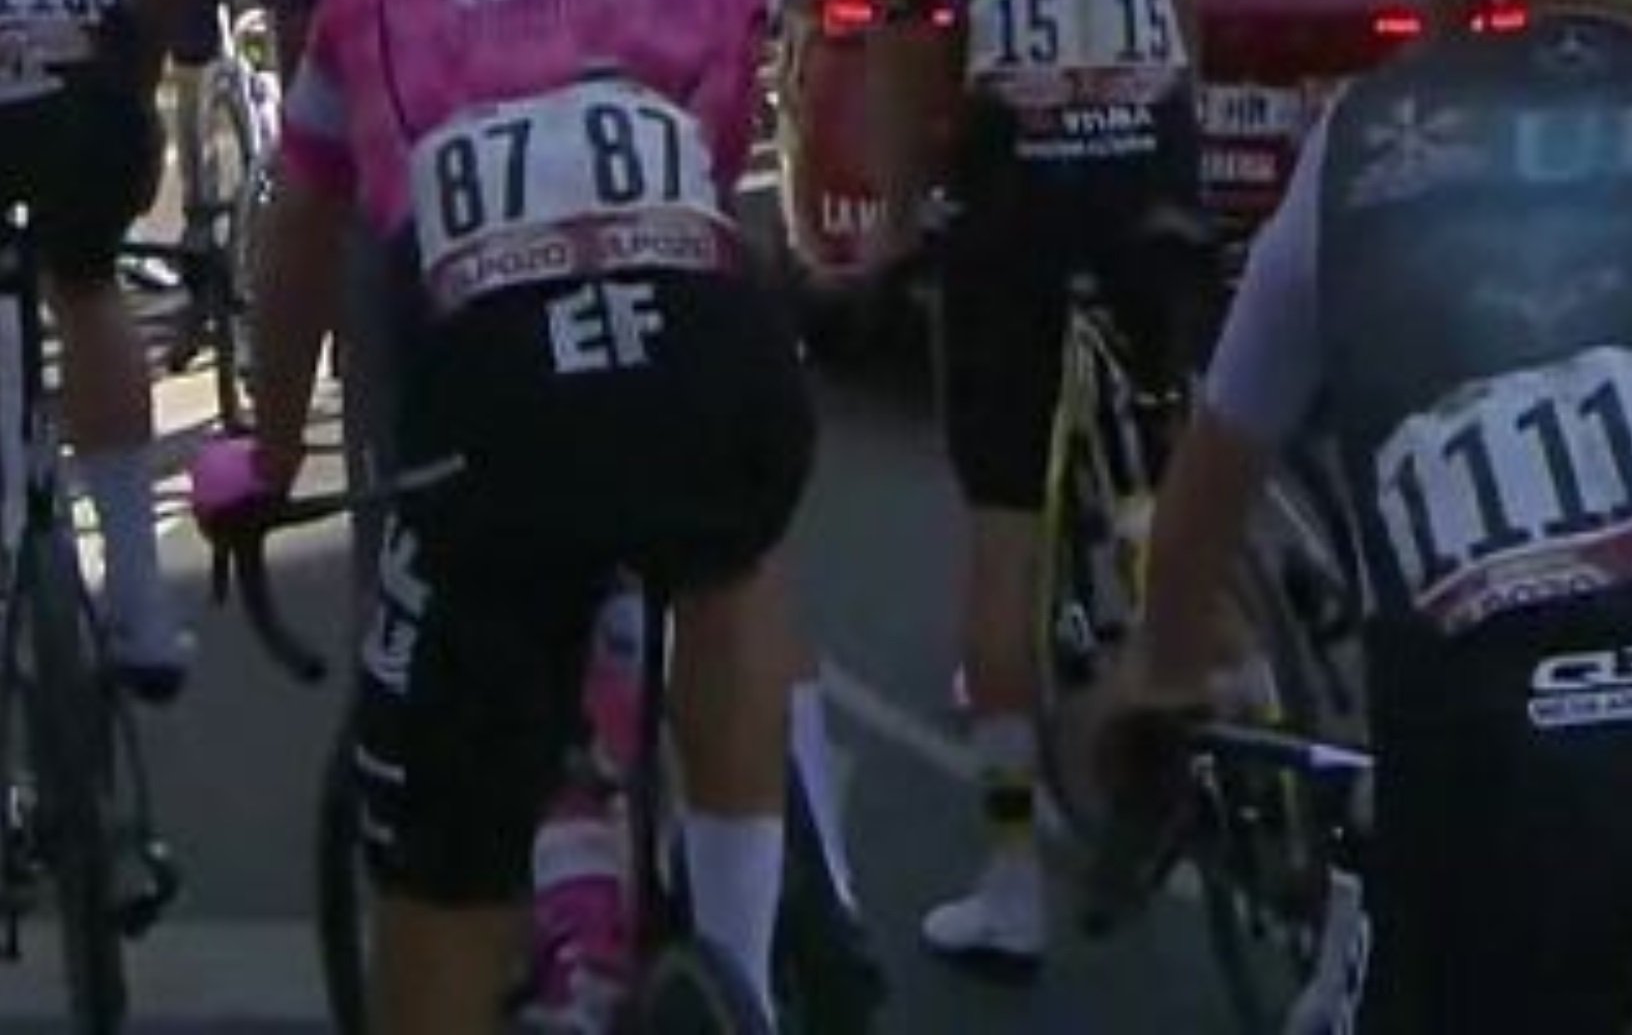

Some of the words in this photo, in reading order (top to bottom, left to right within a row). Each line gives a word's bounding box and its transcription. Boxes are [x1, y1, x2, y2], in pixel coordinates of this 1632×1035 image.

[435, 117, 532, 239] 87
[584, 103, 683, 205] 87
[548, 281, 664, 374] EF
